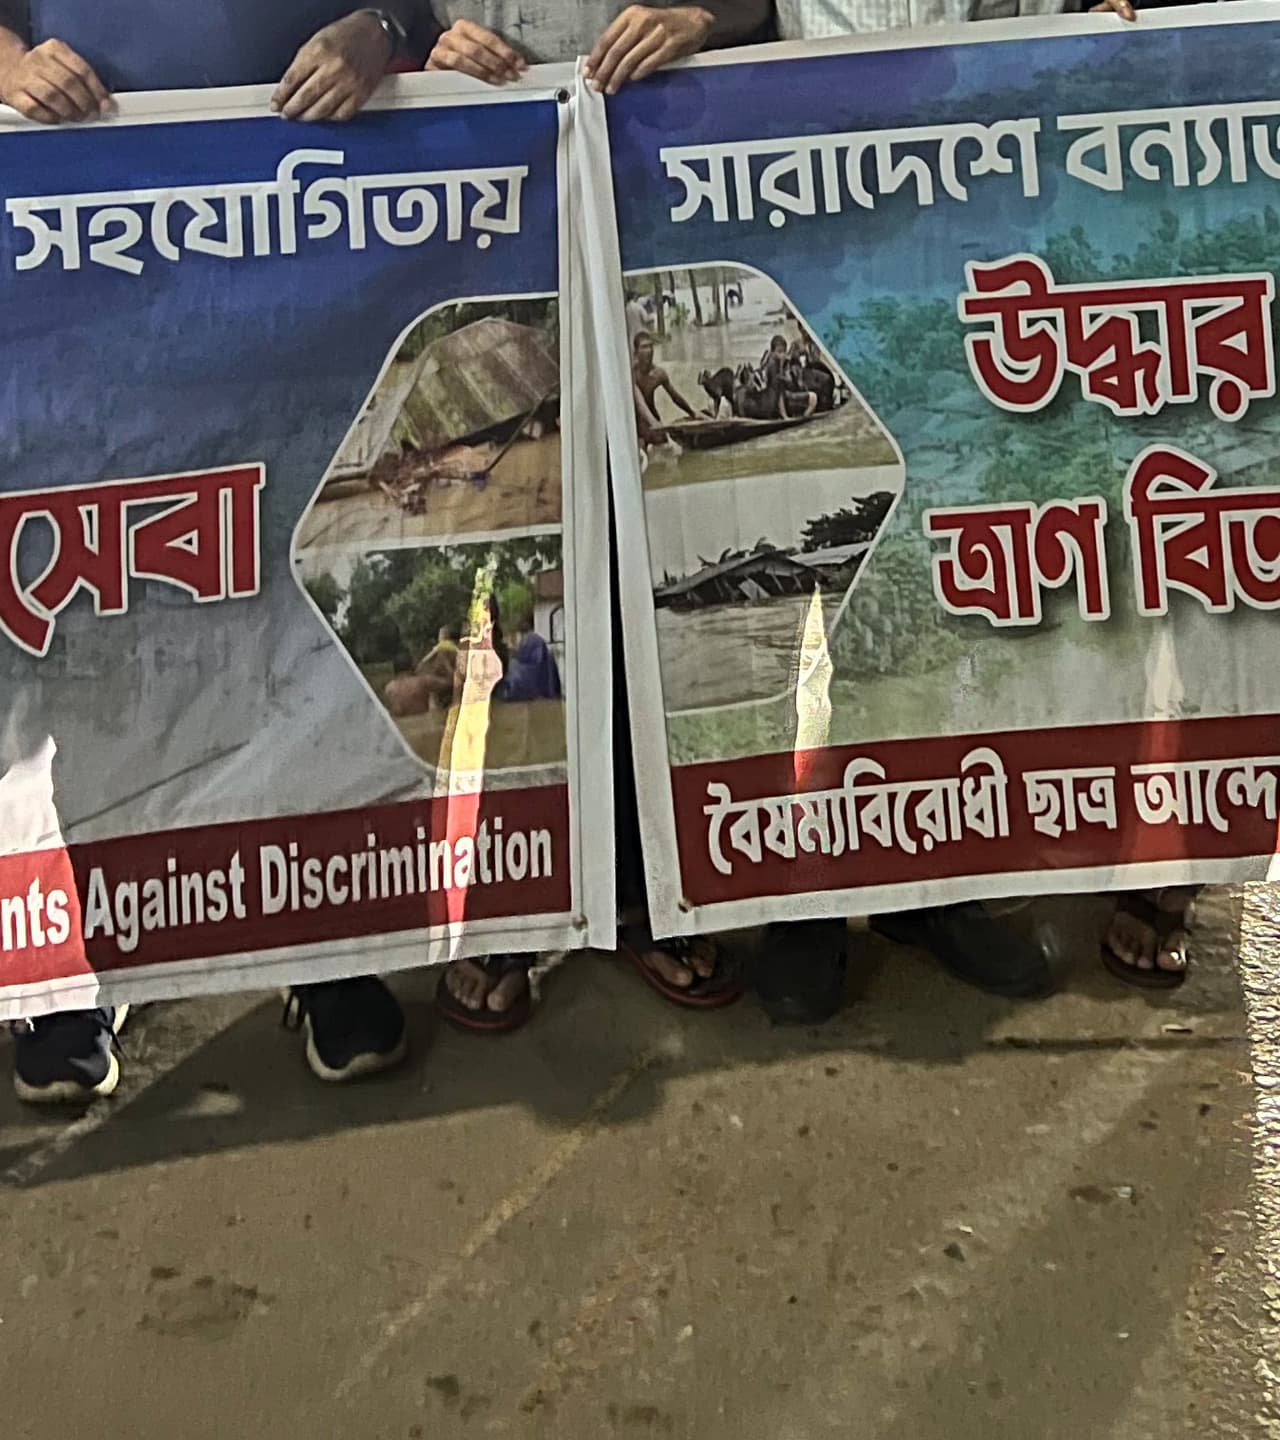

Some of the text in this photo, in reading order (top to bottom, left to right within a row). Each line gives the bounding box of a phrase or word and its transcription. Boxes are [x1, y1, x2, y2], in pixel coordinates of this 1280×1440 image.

[7, 149, 528, 275] সহযোগিতায়
[660, 118, 1040, 228] সারাদেশে
[958, 258, 1274, 422] উদ্ধার
[923, 498, 1111, 626] ত্রাণ
[704, 746, 1009, 875] বৈষম্যবিরোধী
[1023, 765, 1117, 839] ছাত্র
[84, 856, 246, 952] Against
[260, 817, 553, 911] Discrimination
